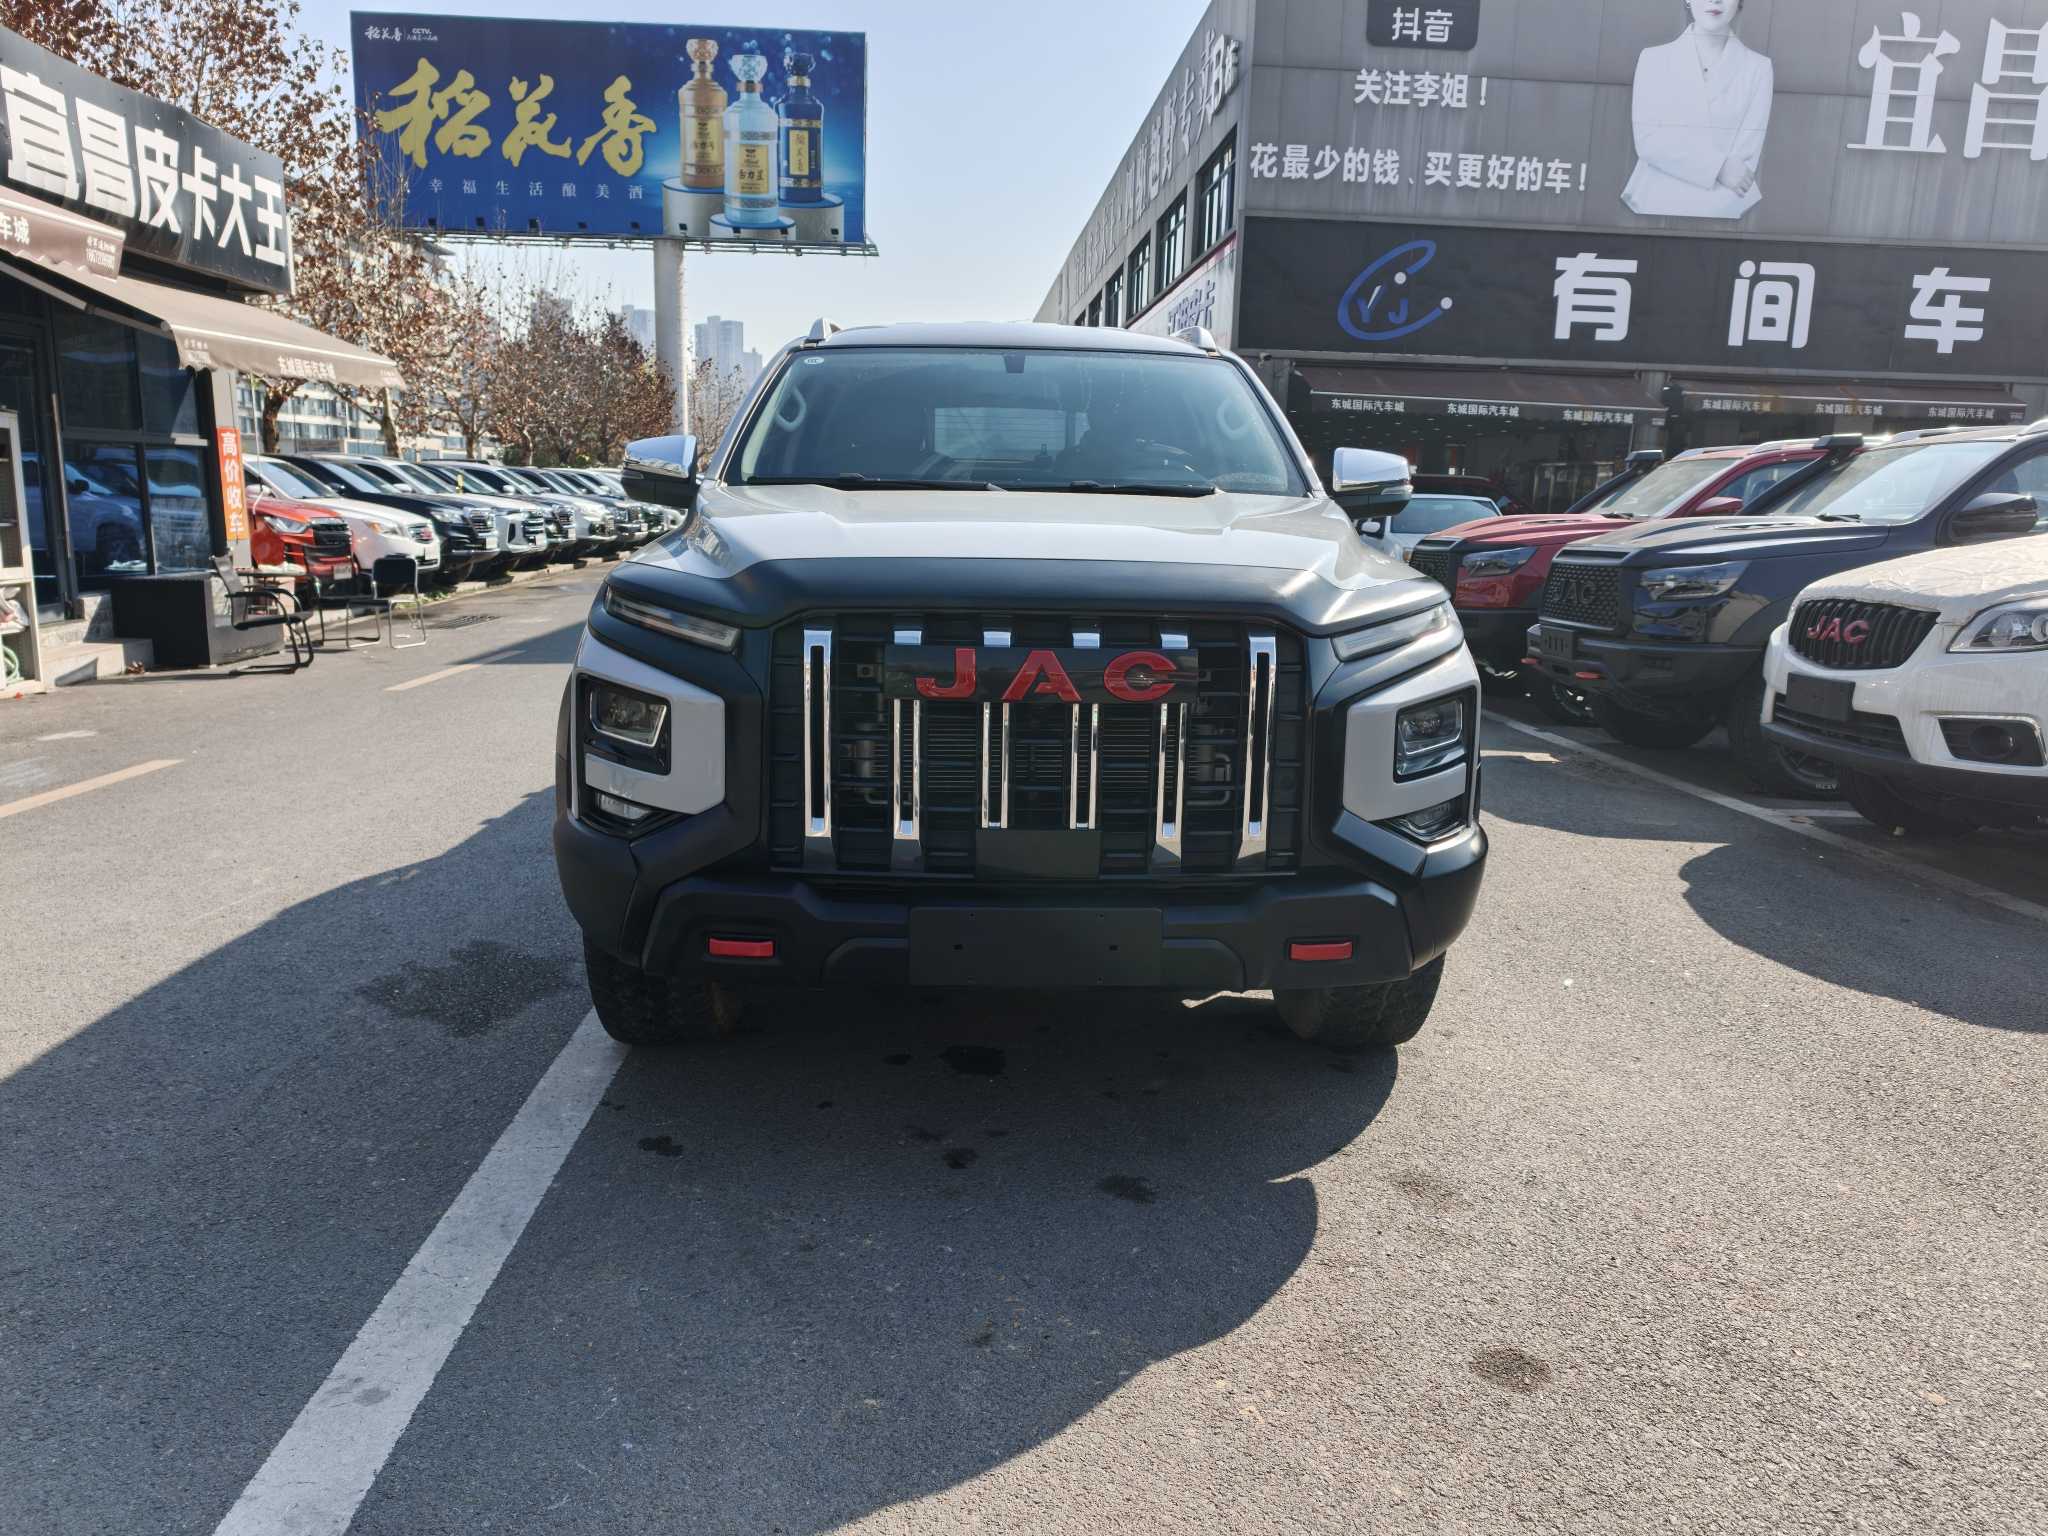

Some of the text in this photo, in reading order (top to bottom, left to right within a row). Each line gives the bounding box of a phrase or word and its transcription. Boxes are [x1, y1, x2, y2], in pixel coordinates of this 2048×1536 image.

[1391, 7, 1454, 43] 抖音
[1846, 11, 2048, 161] 宜昌
[376, 57, 656, 177] 稻花香
[0, 65, 286, 267] 宜昌皮卡大王
[401, 178, 644, 200] 幸福生活酿美酒
[1552, 252, 1992, 354] 有间车
[1331, 398, 1405, 413] 东城国际汽车城
[1447, 402, 1520, 417] 东城国际汽车城
[1562, 409, 1634, 424] 东城国际汽车城
[1702, 399, 1771, 413] 东城国际汽车城
[1815, 403, 1883, 416] 东城国际汽车城
[1927, 406, 1995, 420] 东城国际汽车城
[221, 432, 244, 534] 高价收车
[1551, 577, 1600, 606] JAC
[1807, 615, 1870, 645] JAC
[915, 648, 1177, 701] JAC
